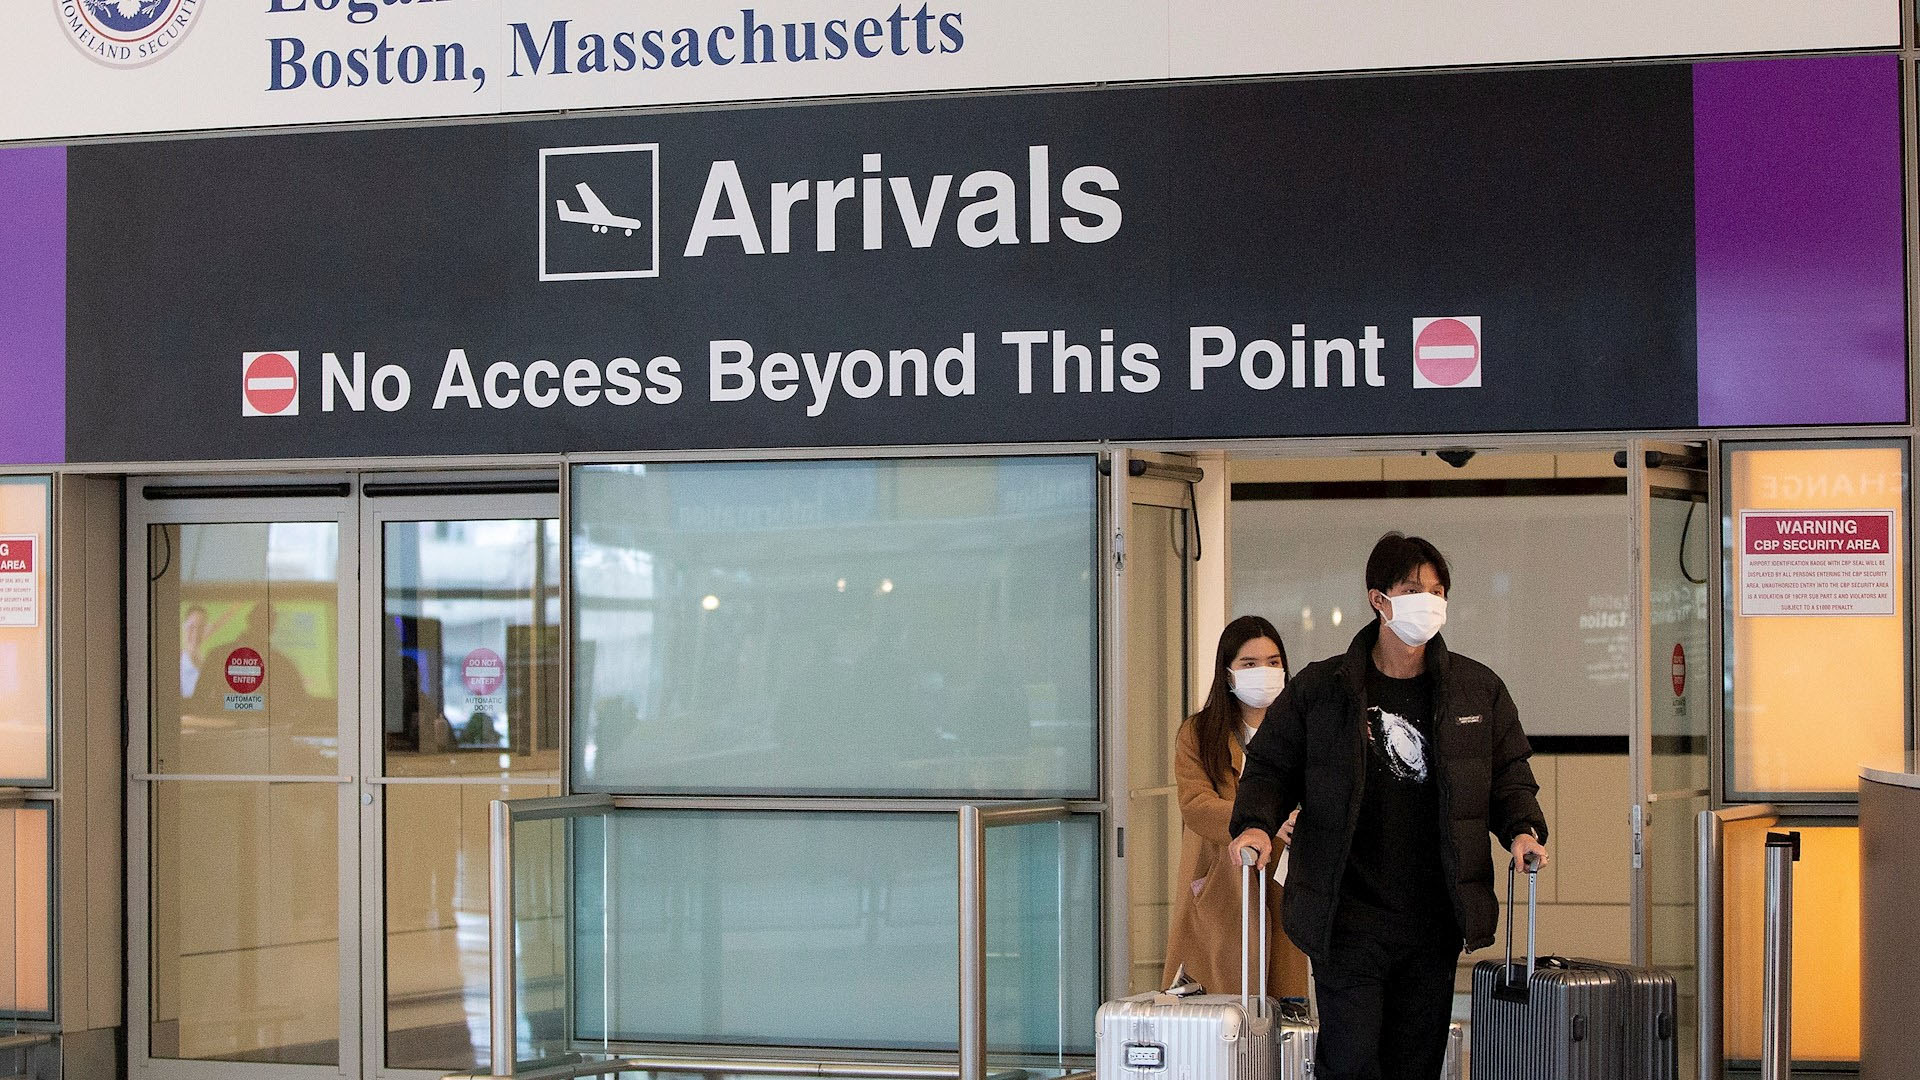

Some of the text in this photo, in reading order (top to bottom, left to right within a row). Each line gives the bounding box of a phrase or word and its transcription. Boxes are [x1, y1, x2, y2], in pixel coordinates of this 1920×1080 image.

[139, 0, 196, 58] SECURIT
[264, 1, 965, 94] Boston, Massachusetts
[683, 144, 1123, 257] Arrivals
[321, 324, 1385, 417] No Access Beyond This Point
[1775, 519, 1858, 535] WARNING
[1753, 539, 1880, 551] CBP SECURITY AREA
[0, 559, 26, 570] AREA
[231, 658, 258, 666] DO NOT
[469, 659, 497, 667] DO NOT
[232, 676, 256, 684] ENTER
[471, 677, 495, 685] ENTER
